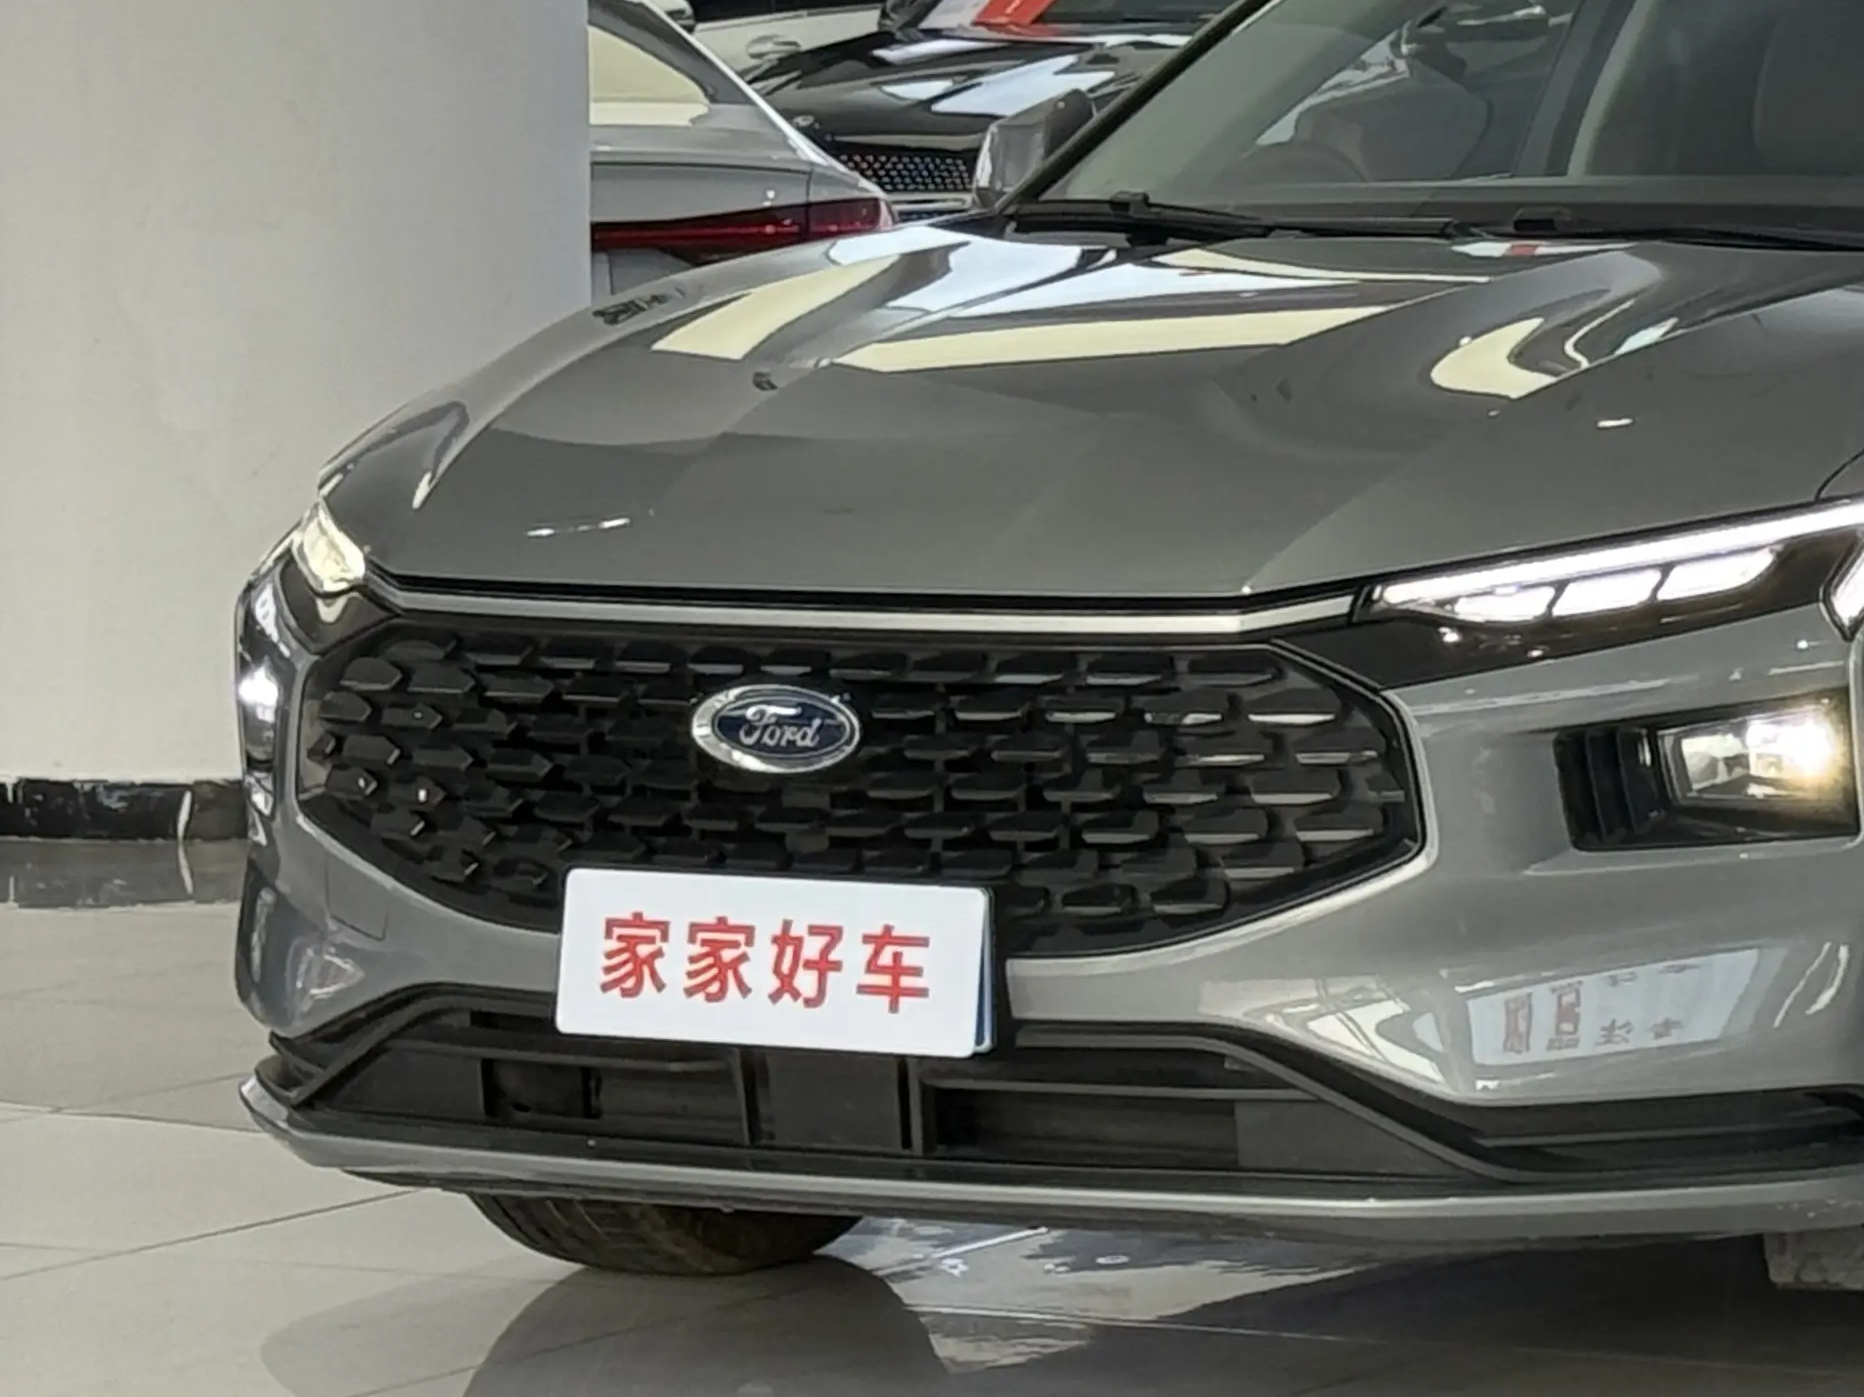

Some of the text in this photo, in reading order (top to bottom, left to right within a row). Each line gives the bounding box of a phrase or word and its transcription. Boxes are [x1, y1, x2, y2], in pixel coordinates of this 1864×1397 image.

[739, 705, 823, 748] Ford
[600, 912, 930, 1014] 家家好车
